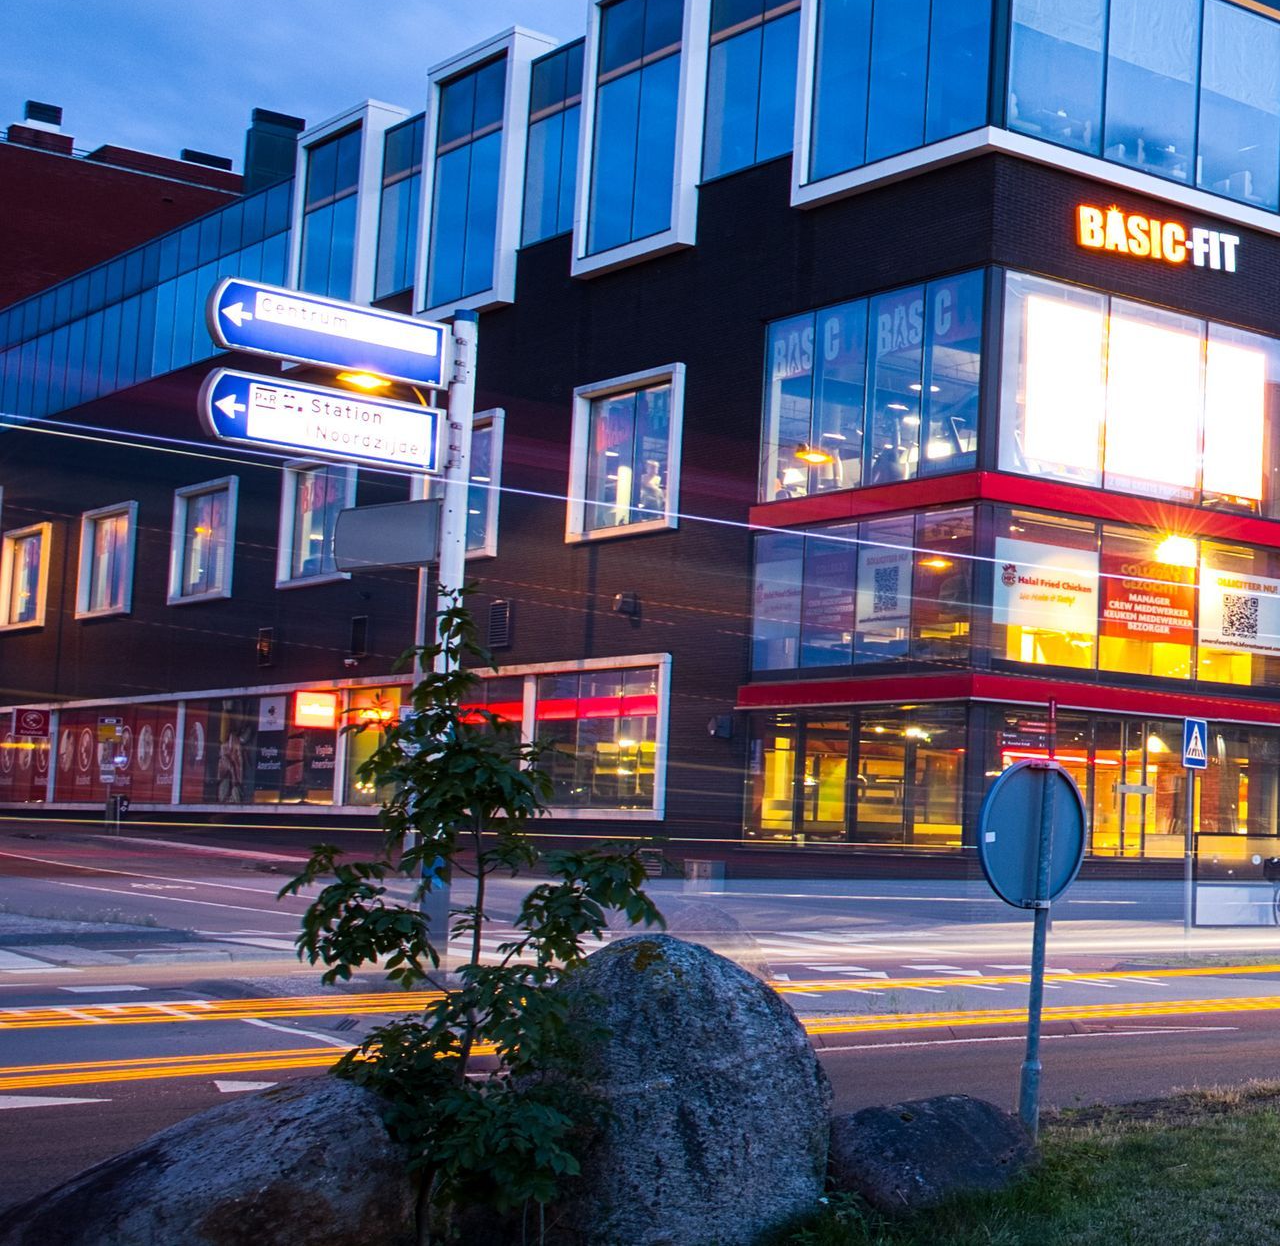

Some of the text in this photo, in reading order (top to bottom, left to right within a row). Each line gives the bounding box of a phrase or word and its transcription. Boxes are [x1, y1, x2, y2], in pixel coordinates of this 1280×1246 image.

[262, 297, 348, 331] Centrum
[311, 399, 383, 425] Station
[1018, 575, 1092, 593] Halal Fried Chicken
[1215, 576, 1278, 594] OLLICITEER NU!
[1109, 600, 1189, 617] CREW MEDEWERKER
[1129, 593, 1171, 606] MANAGER
[1104, 609, 1193, 627] KEUKEN MEDEWERKER
[1127, 620, 1171, 634] BEZORGER
[311, 760, 335, 770] Amersfoor
